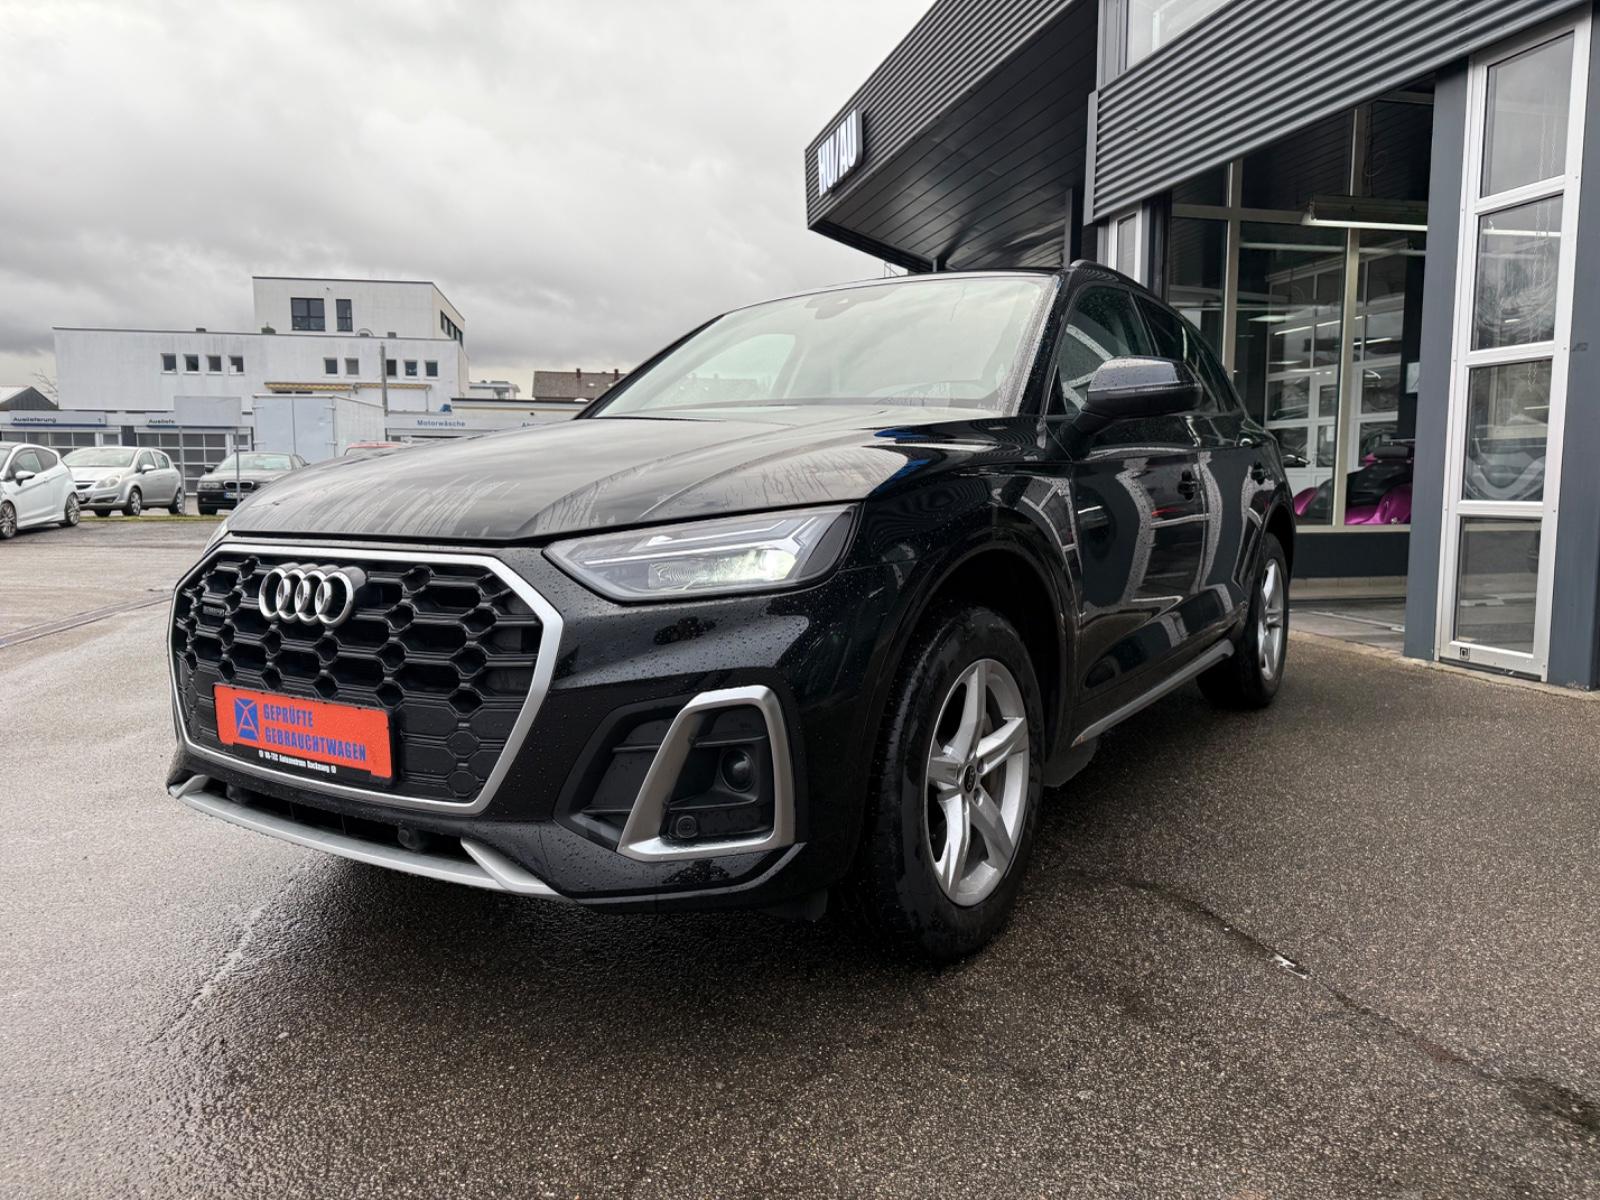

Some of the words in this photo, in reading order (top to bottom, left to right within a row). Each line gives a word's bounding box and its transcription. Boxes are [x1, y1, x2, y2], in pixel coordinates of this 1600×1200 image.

[817, 110, 857, 197] HU/AU
[417, 419, 466, 427] Motorwäsche
[263, 703, 314, 728] GEPRÜFTE
[264, 726, 367, 761] GEBRAUCHTWAGEN
